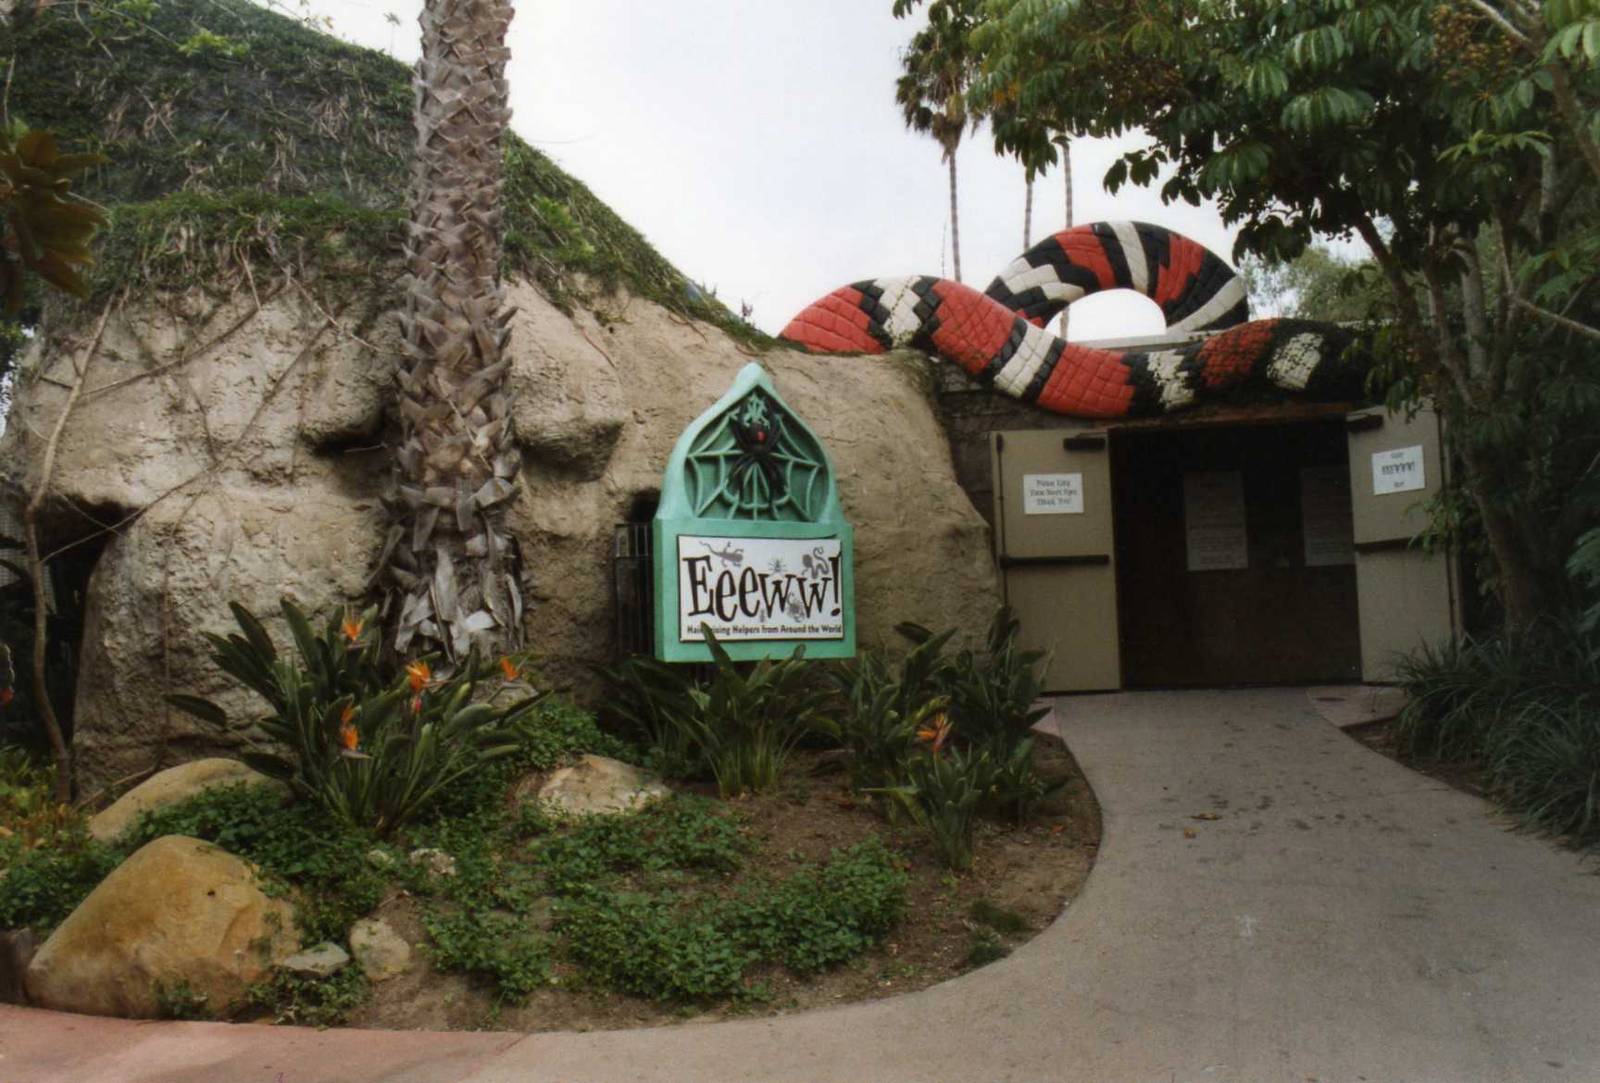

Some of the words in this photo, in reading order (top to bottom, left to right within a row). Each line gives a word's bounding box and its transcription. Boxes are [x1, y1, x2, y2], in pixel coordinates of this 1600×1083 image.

[732, 624, 760, 636] Helpers
[761, 624, 779, 633] from
[780, 624, 807, 633] Around
[808, 624, 819, 633] the
[821, 623, 842, 633] World
